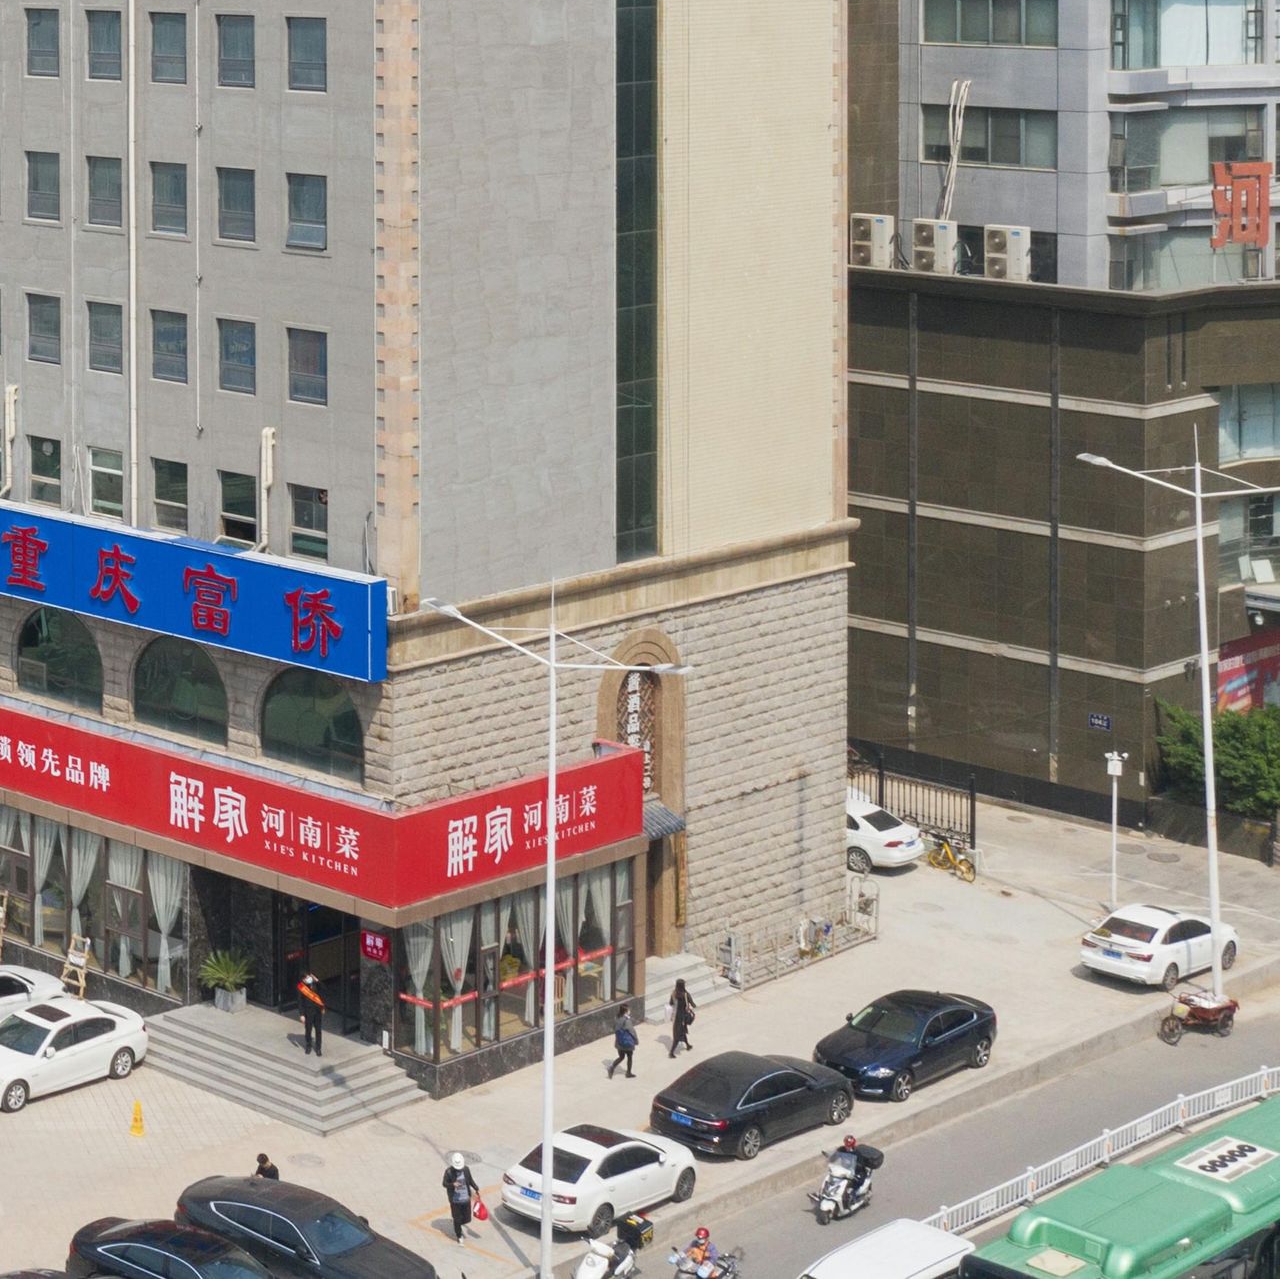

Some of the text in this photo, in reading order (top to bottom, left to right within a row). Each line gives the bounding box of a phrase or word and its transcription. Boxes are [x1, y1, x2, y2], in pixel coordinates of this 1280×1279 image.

[0, 525, 344, 658] 重庆富侨
[169, 770, 360, 860] 解家 河南菜
[264, 840, 359, 876] XIE'S KITCHEN
[447, 784, 598, 878] 解家 河南菜
[555, 821, 596, 841] KITCHEN
